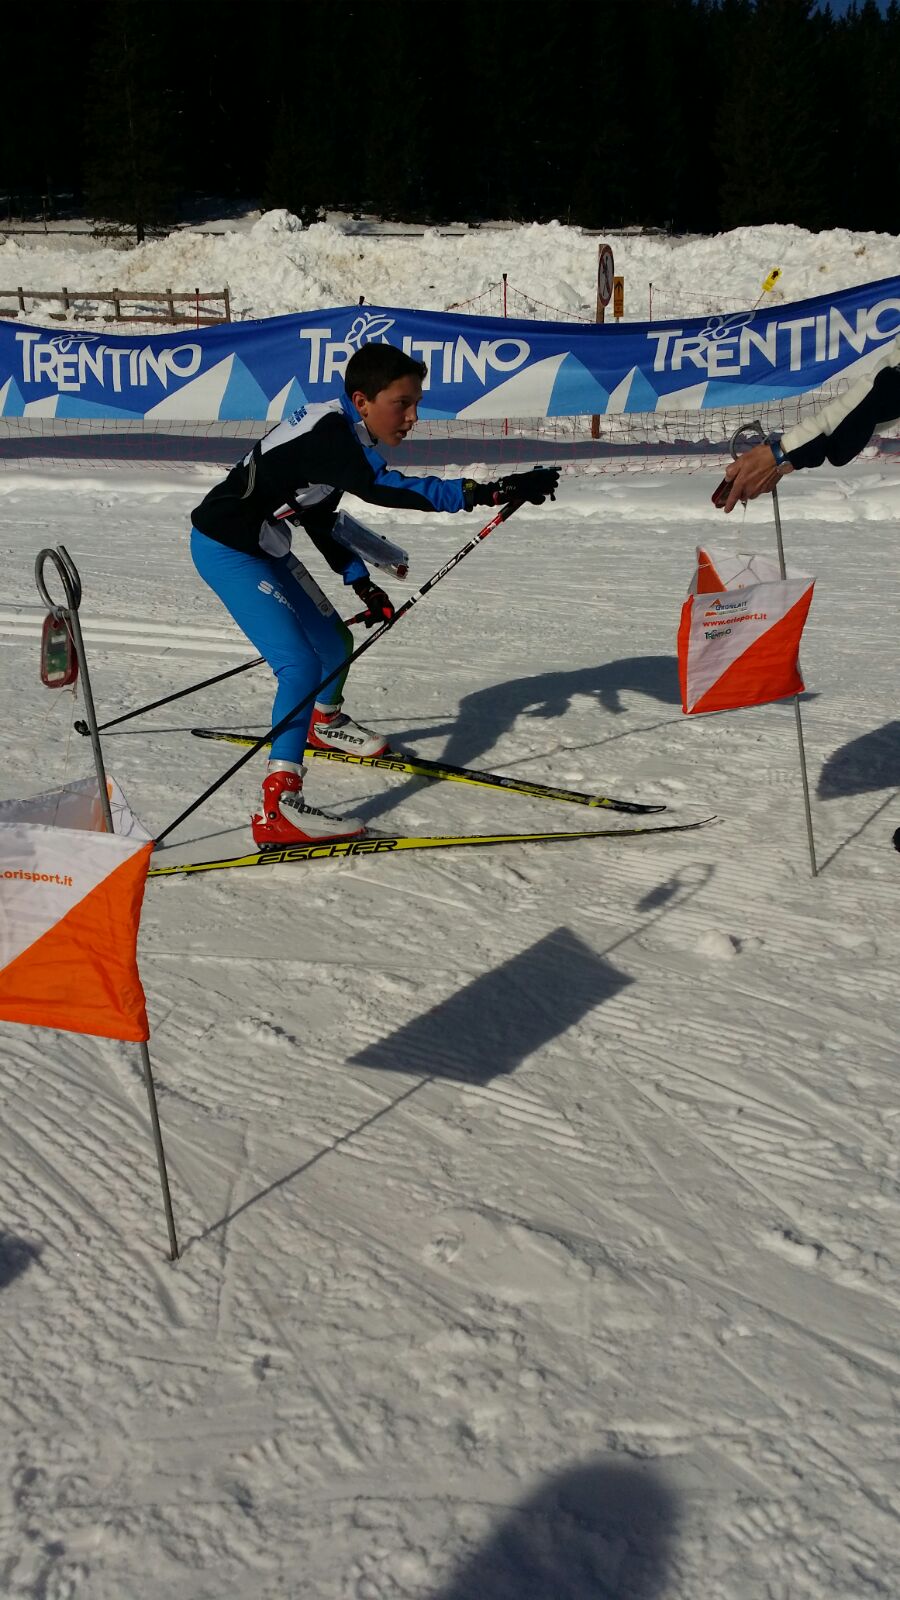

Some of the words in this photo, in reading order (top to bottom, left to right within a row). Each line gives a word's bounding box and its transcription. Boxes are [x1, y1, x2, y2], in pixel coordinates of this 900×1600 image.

[647, 298, 900, 377] TRENTINO
[15, 331, 202, 392] TRENTINO
[300, 328, 531, 391] TRTINO
[703, 613, 767, 627] www.orisport.it
[312, 751, 406, 772] FISCHER
[256, 840, 398, 865] FISCHER
